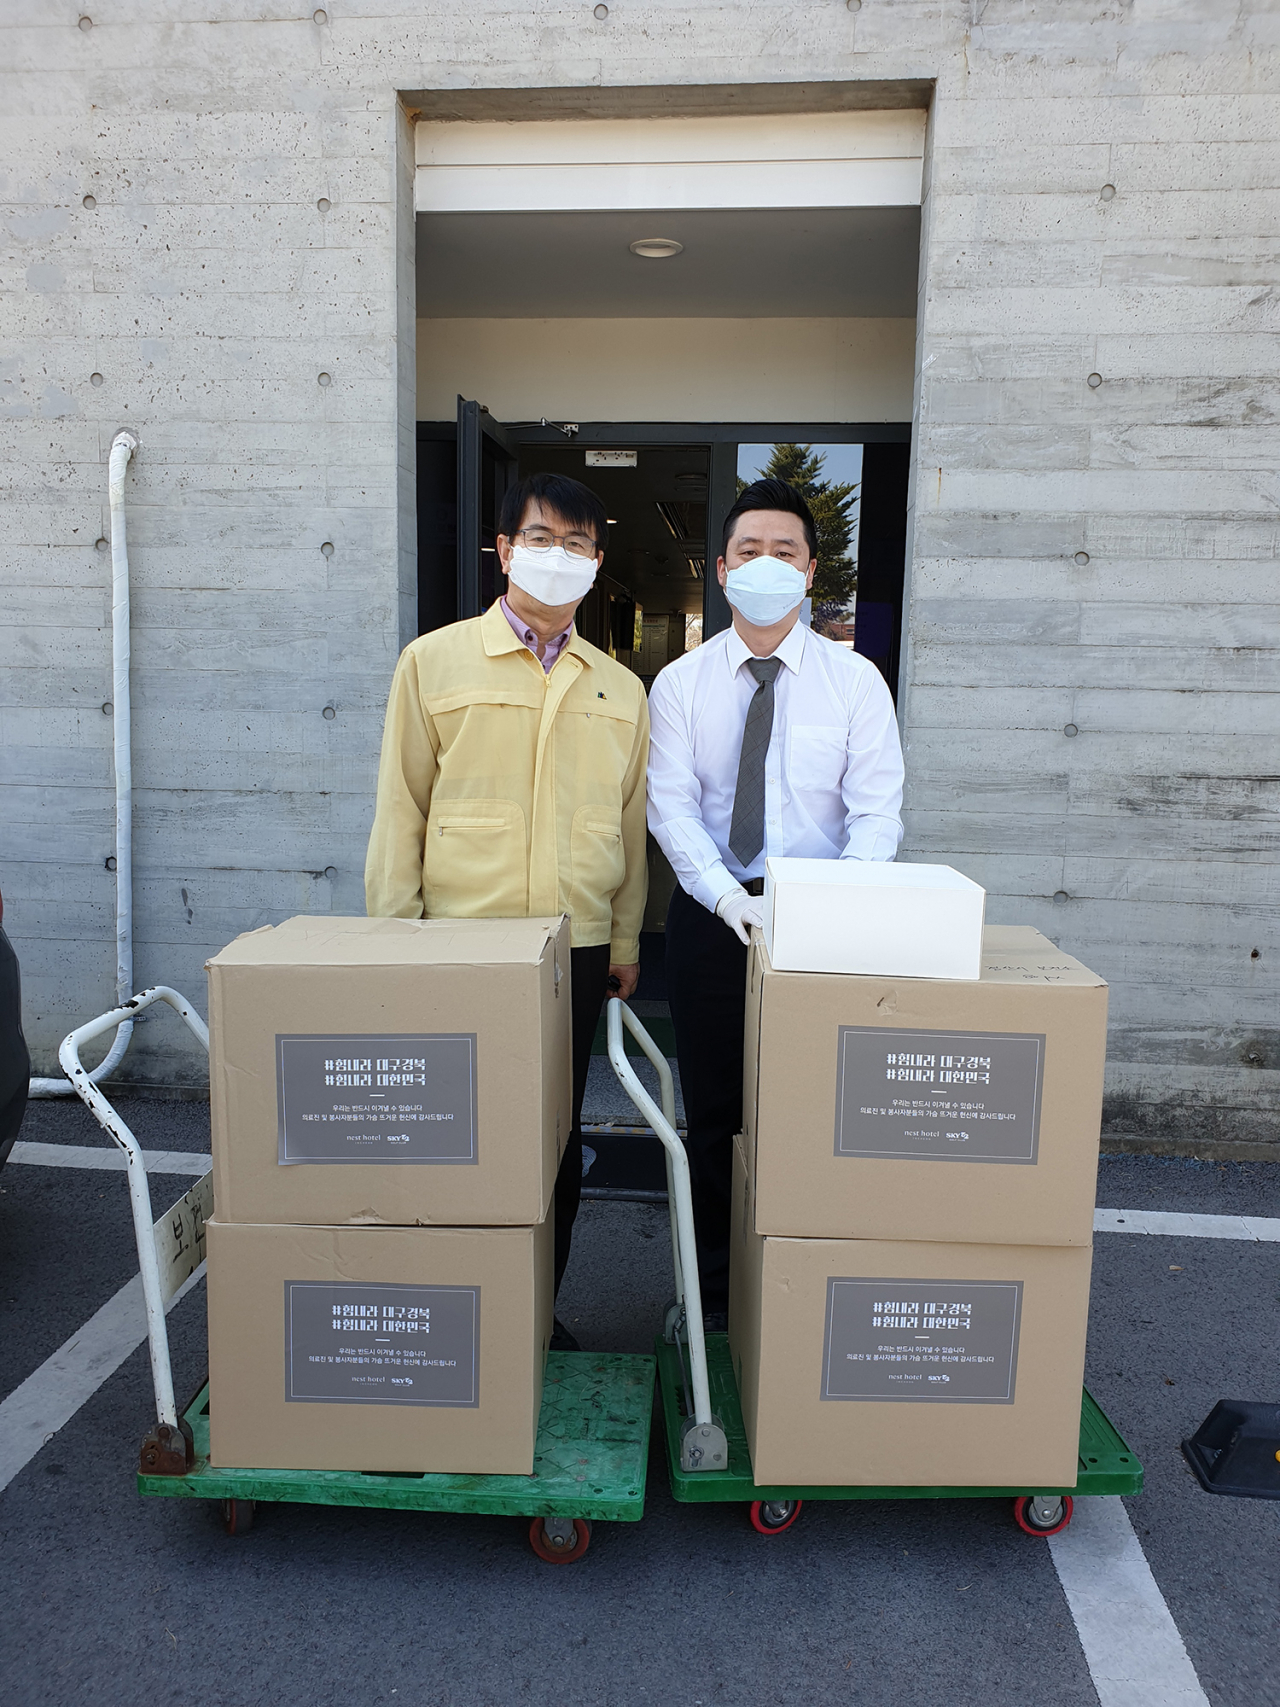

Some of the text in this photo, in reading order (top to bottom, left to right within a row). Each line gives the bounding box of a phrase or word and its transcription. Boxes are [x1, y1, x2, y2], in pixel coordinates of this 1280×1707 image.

[325, 1059, 425, 1071] #힘내라 대구경북
[887, 1053, 991, 1069] #힘내라 대구경북
[325, 1074, 425, 1086] #힘내라 대한민국
[887, 1068, 990, 1084] #힘내라 대한민국
[892, 1099, 910, 1107] 우리는
[860, 1107, 878, 1115] 의료진
[332, 1305, 430, 1319] #힘내라 대구경북
[874, 1302, 971, 1315] #힘내라 대구경북
[332, 1319, 430, 1333] #힘내라 대한민국
[873, 1316, 970, 1329] #힘내라 대한민국
